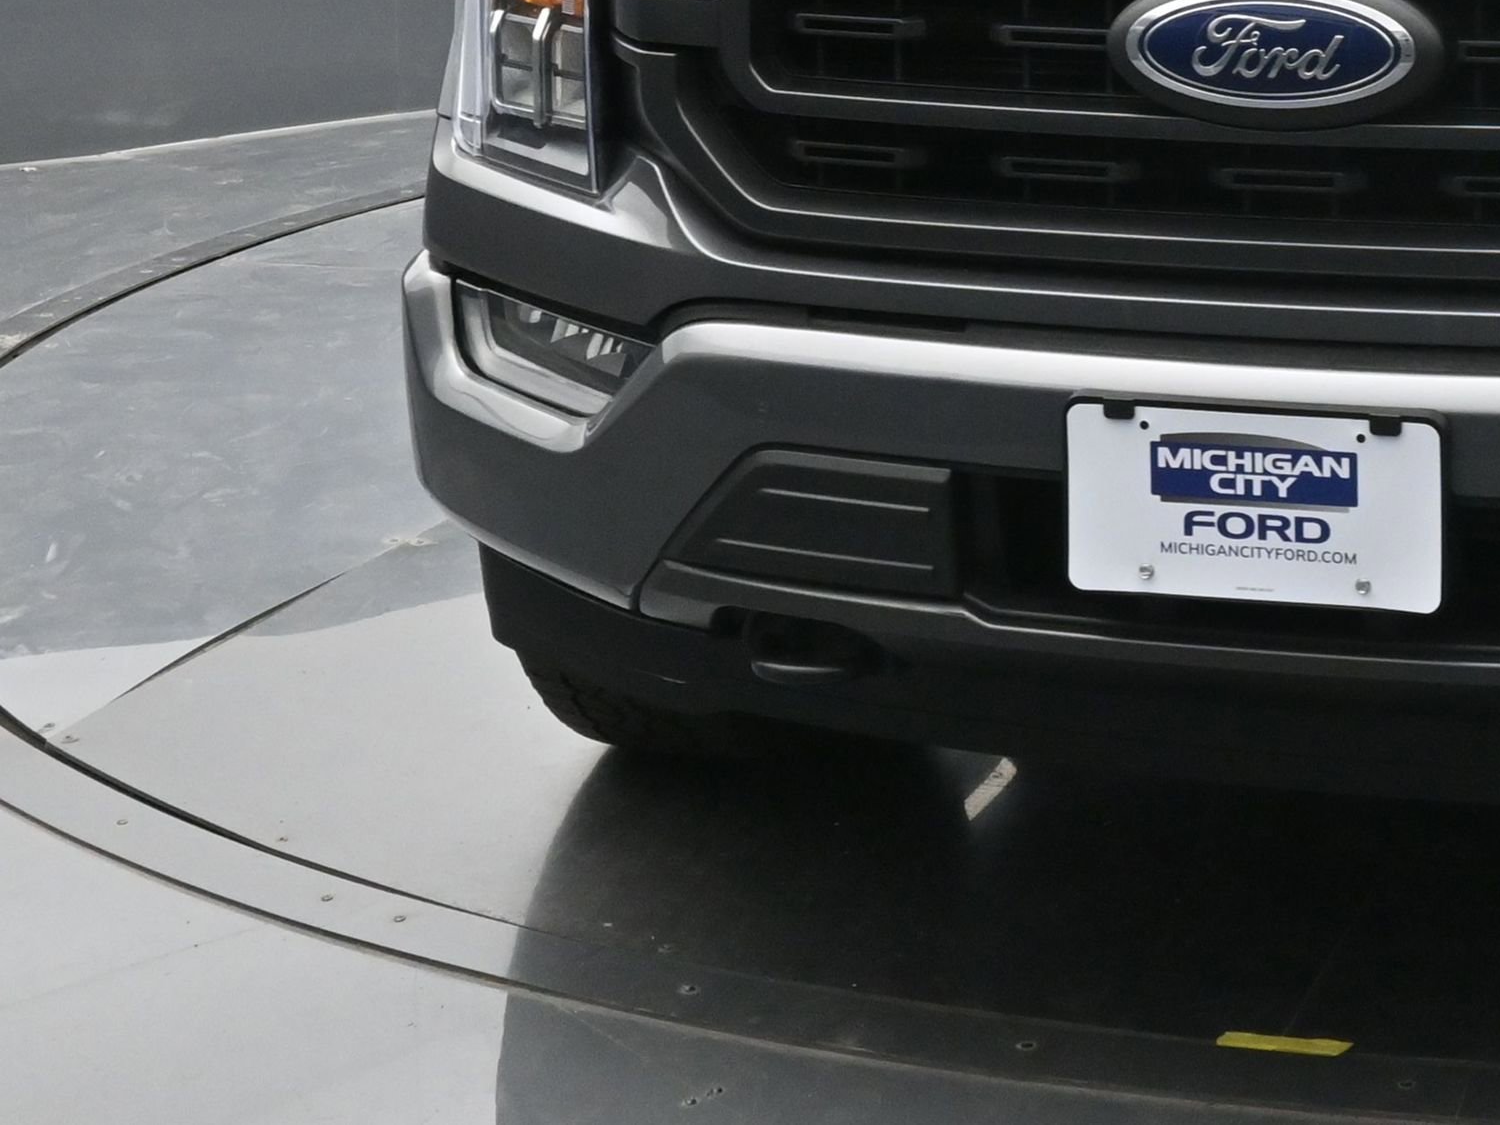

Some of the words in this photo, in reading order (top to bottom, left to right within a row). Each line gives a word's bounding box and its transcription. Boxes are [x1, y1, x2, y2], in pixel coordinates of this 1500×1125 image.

[1191, 14, 1344, 81] Ford
[1156, 446, 1351, 479] MICHIGAN
[1209, 472, 1299, 498] CITY
[1183, 510, 1331, 544] FORD
[1160, 541, 1357, 565] MICHIGANCITYFORD.COM
